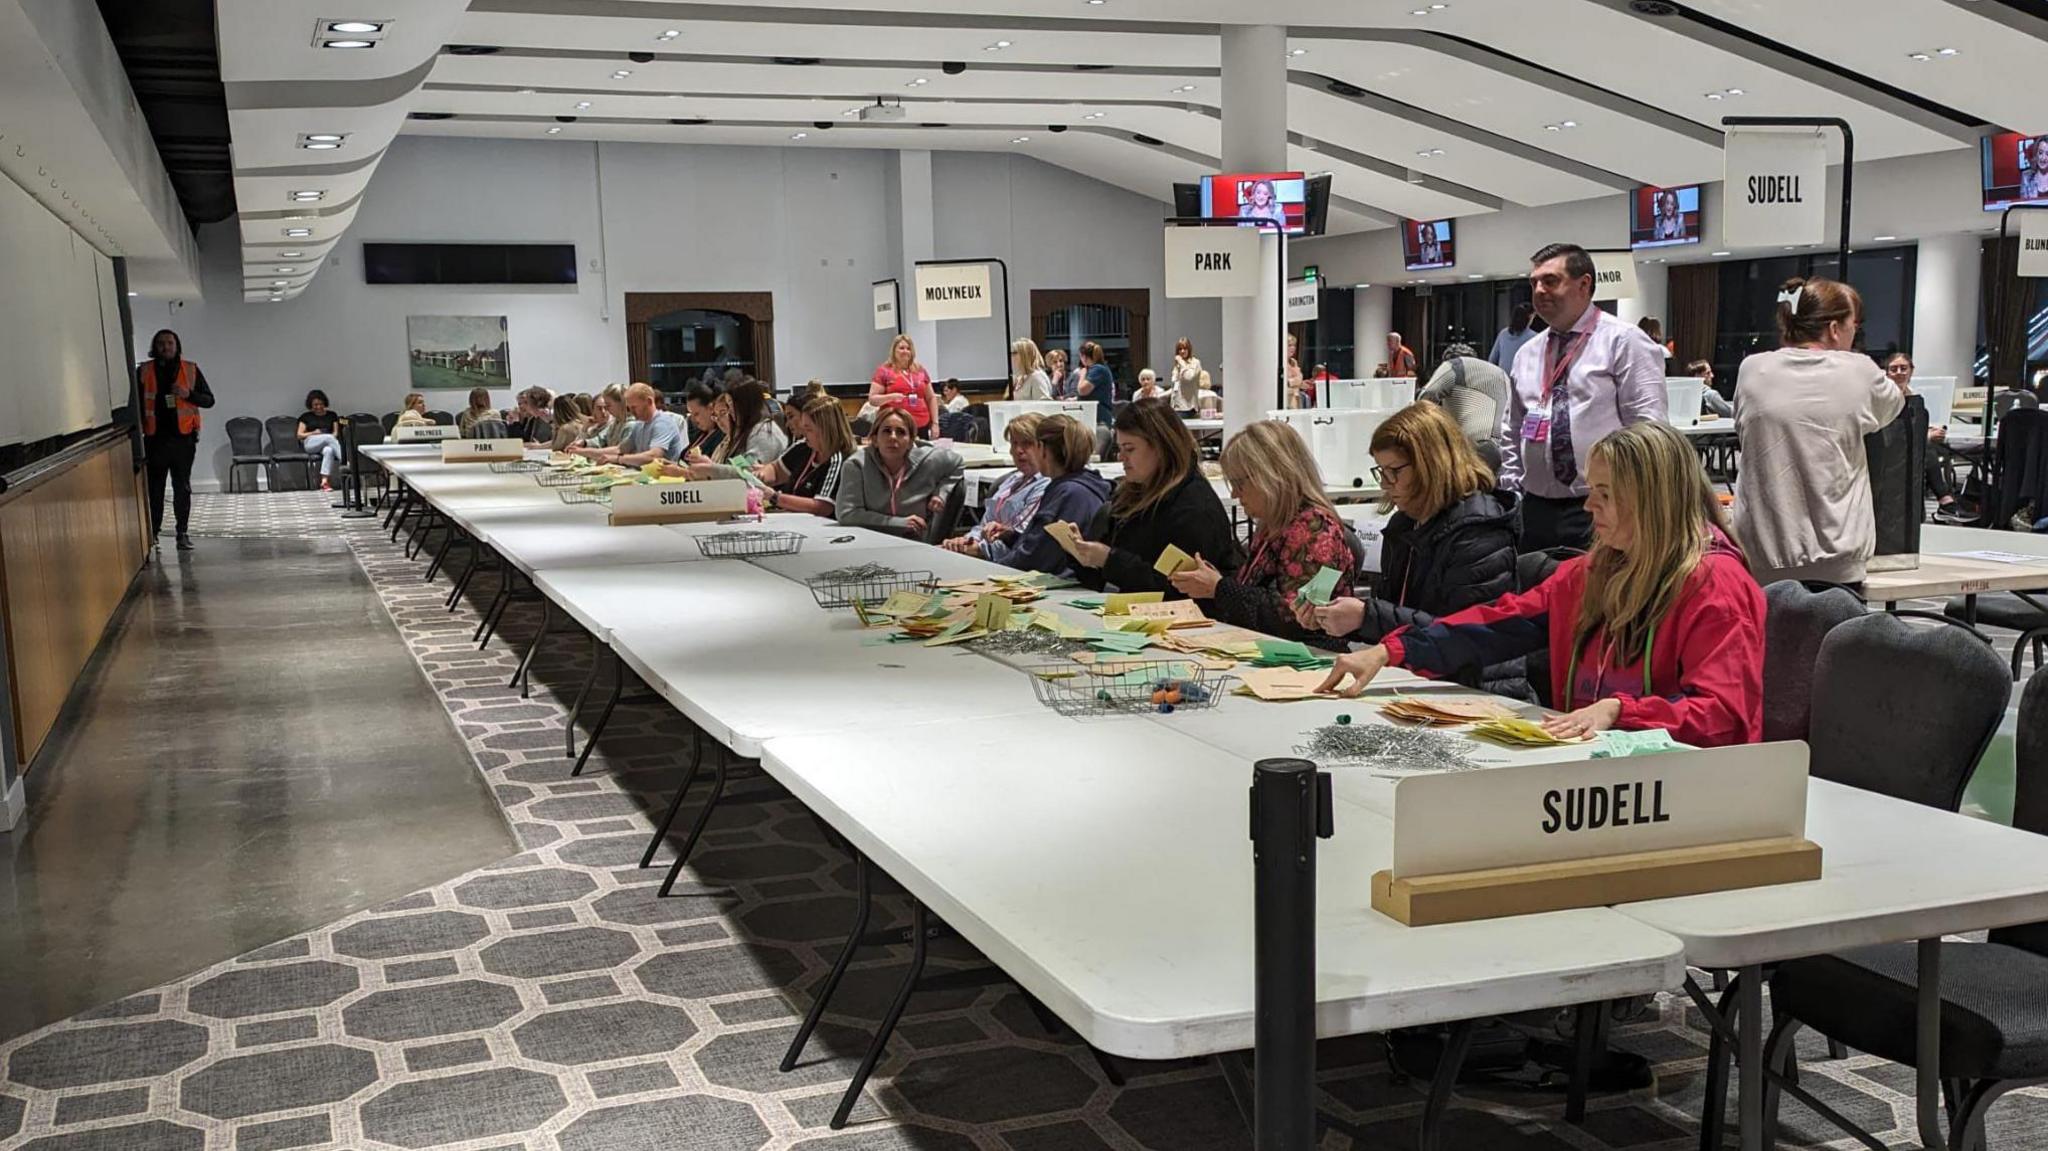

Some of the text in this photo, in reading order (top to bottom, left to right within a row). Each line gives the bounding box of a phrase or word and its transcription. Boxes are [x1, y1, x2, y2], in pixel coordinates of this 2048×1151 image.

[1748, 175, 1802, 204] SUDELL
[1195, 252, 1231, 271] PARK
[1595, 270, 1622, 284] ANOR
[925, 285, 982, 301] MOLYNEUX
[474, 443, 493, 452] PARK
[660, 490, 703, 505] SUDELL
[1542, 780, 1670, 834] SUDELL
